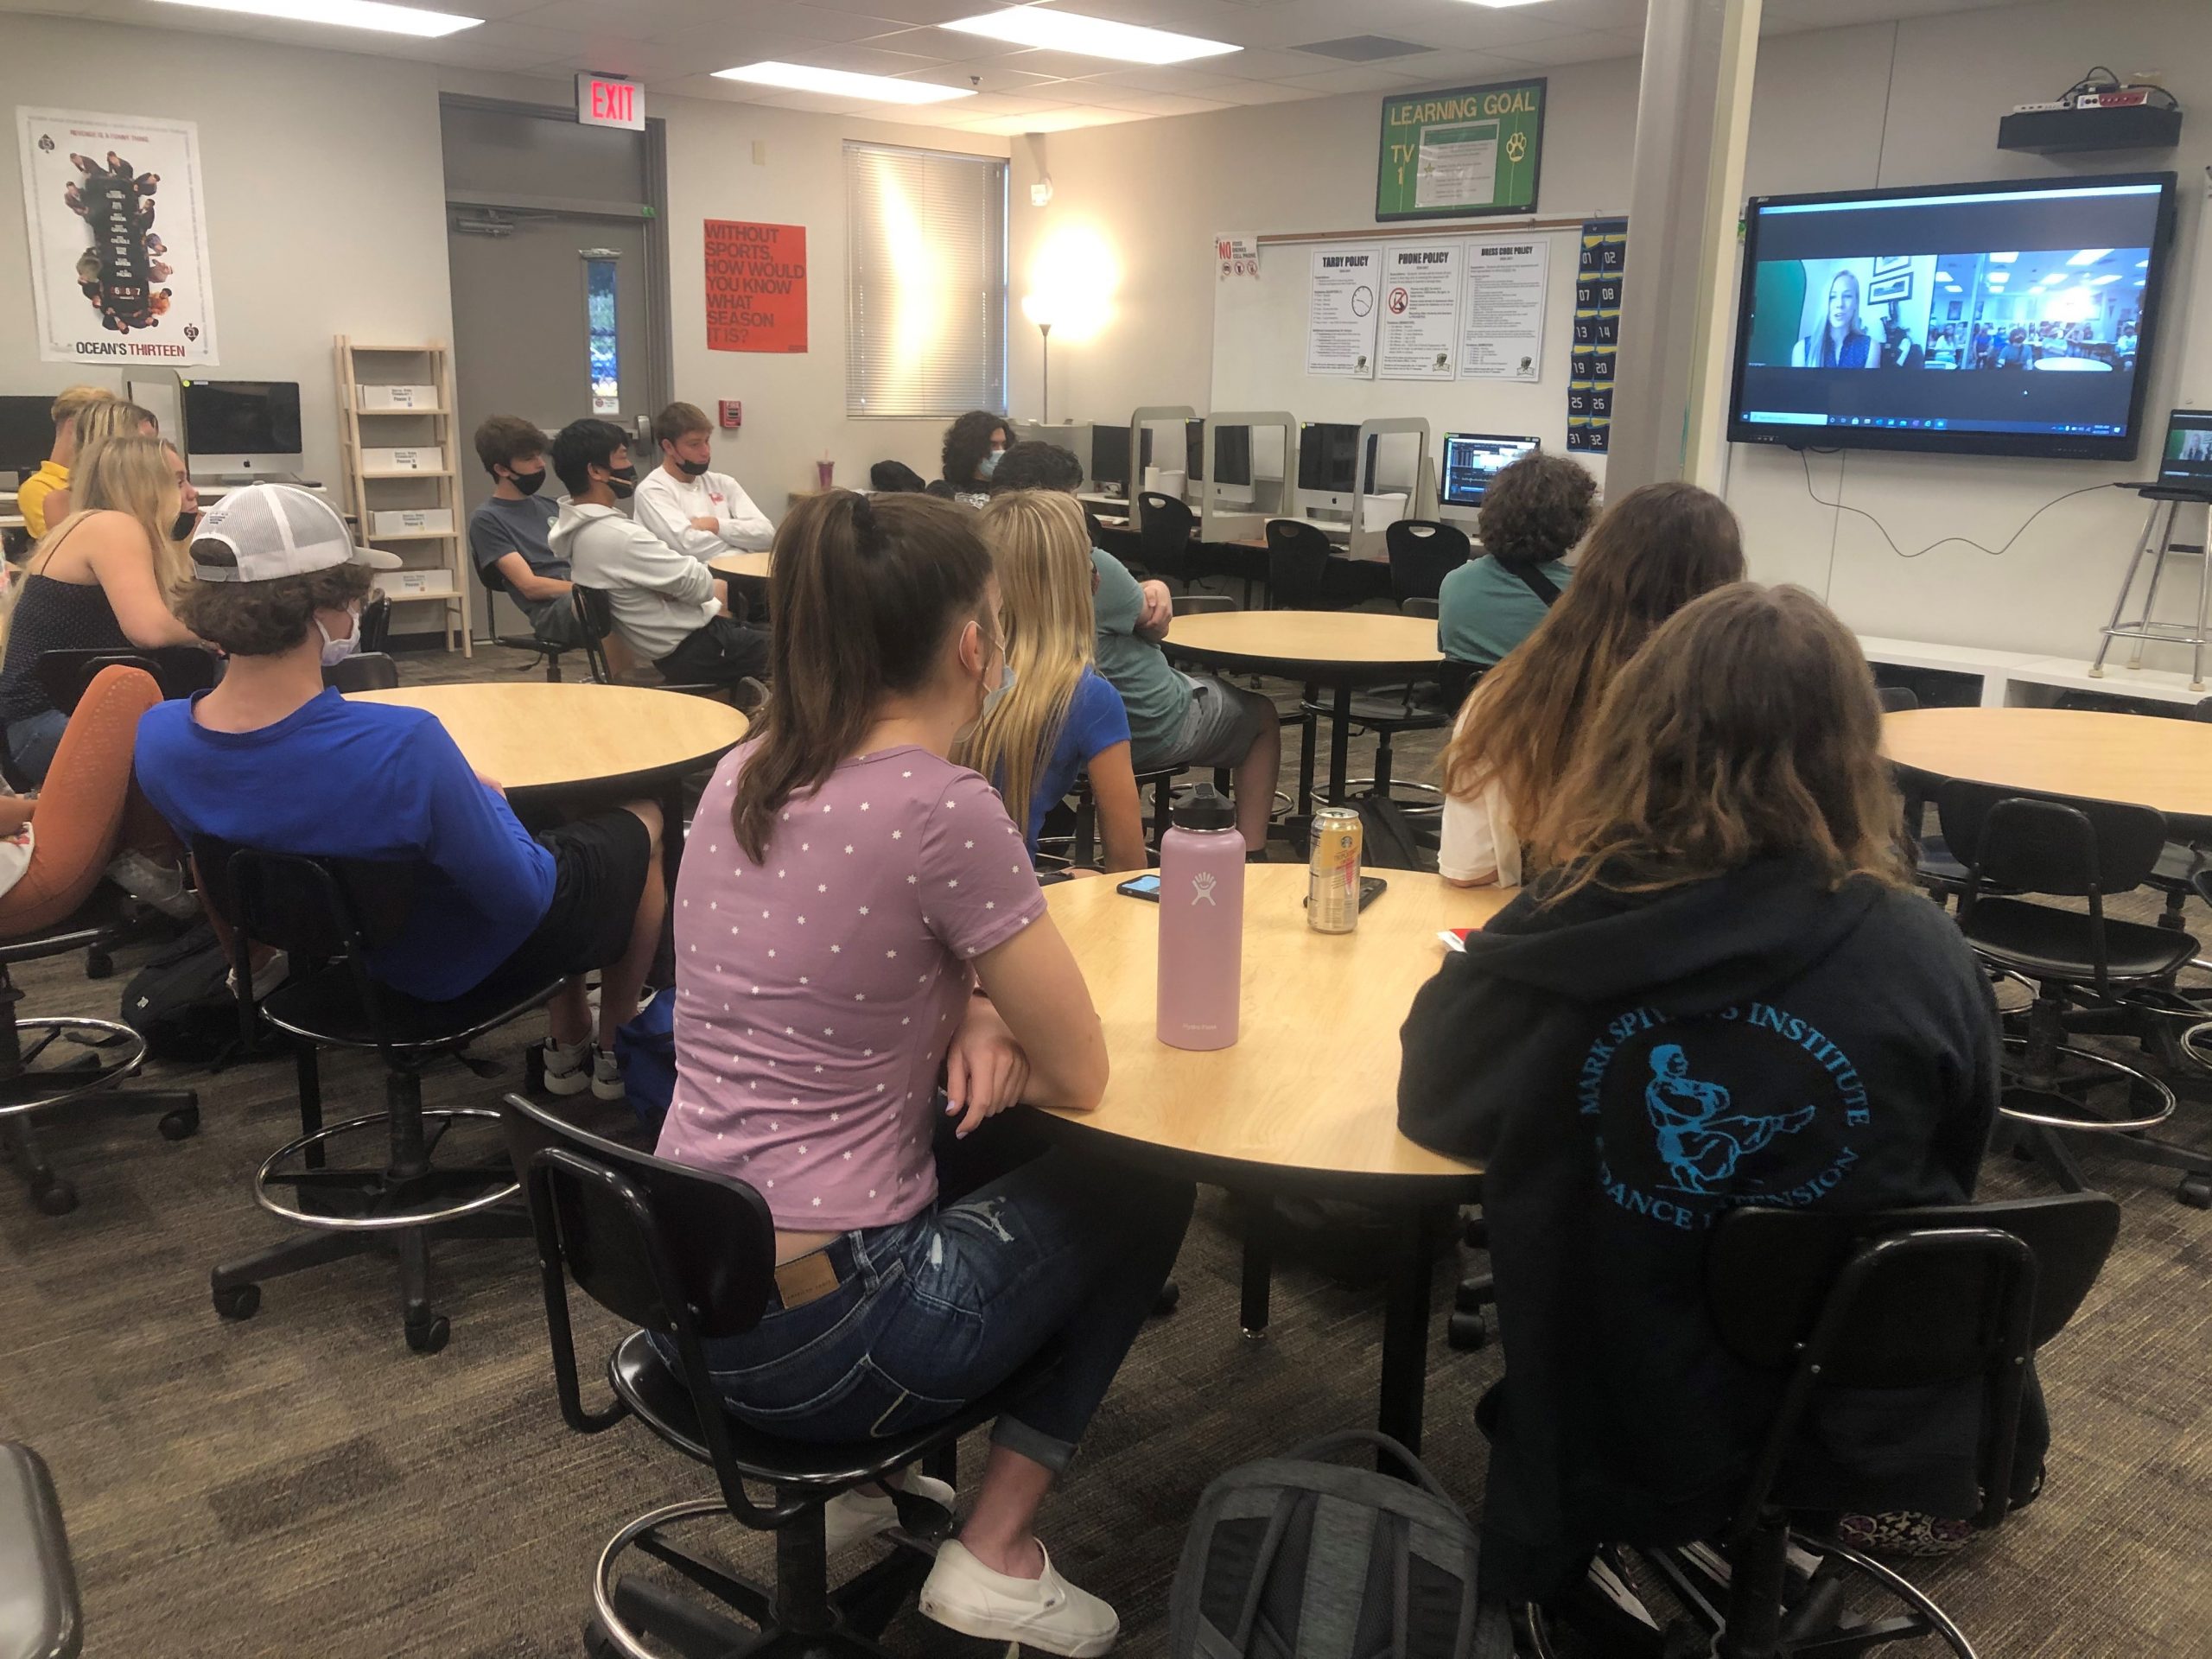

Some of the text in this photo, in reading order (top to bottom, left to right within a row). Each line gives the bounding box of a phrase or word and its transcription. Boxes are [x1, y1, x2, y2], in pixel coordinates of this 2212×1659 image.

[590, 80, 634, 122] EXIT
[1390, 92, 1535, 125] LEARNING GOAL
[1390, 144, 1415, 163] TV
[1397, 167, 1404, 185] 1
[705, 224, 779, 243] WITHOUT
[705, 241, 773, 262] SPORTS,
[1219, 241, 1231, 260] NO
[1398, 251, 1449, 264] PHONE POLICY
[1481, 247, 1498, 256] DRESS
[1514, 246, 1533, 255] POLICY
[1582, 251, 1617, 264] 01 02
[706, 259, 804, 279] HOW WOULD
[1323, 255, 1369, 267] TARDY POLICY
[707, 276, 792, 295] YOU KNOW
[707, 293, 753, 309] WHAT
[1580, 288, 1614, 302] 07 08
[707, 311, 774, 327] SEASON
[708, 328, 748, 344] IT IS?
[1576, 325, 1611, 338] 13 14
[75, 341, 186, 357] OCEAN'S THIRTEEN
[1573, 361, 1608, 374] 19 20
[1571, 397, 1605, 410] 25 26
[1569, 433, 1603, 446] 31 32
[1578, 1036, 1615, 1115] MARK
[1747, 1001, 1871, 1127] INSTITUTE
